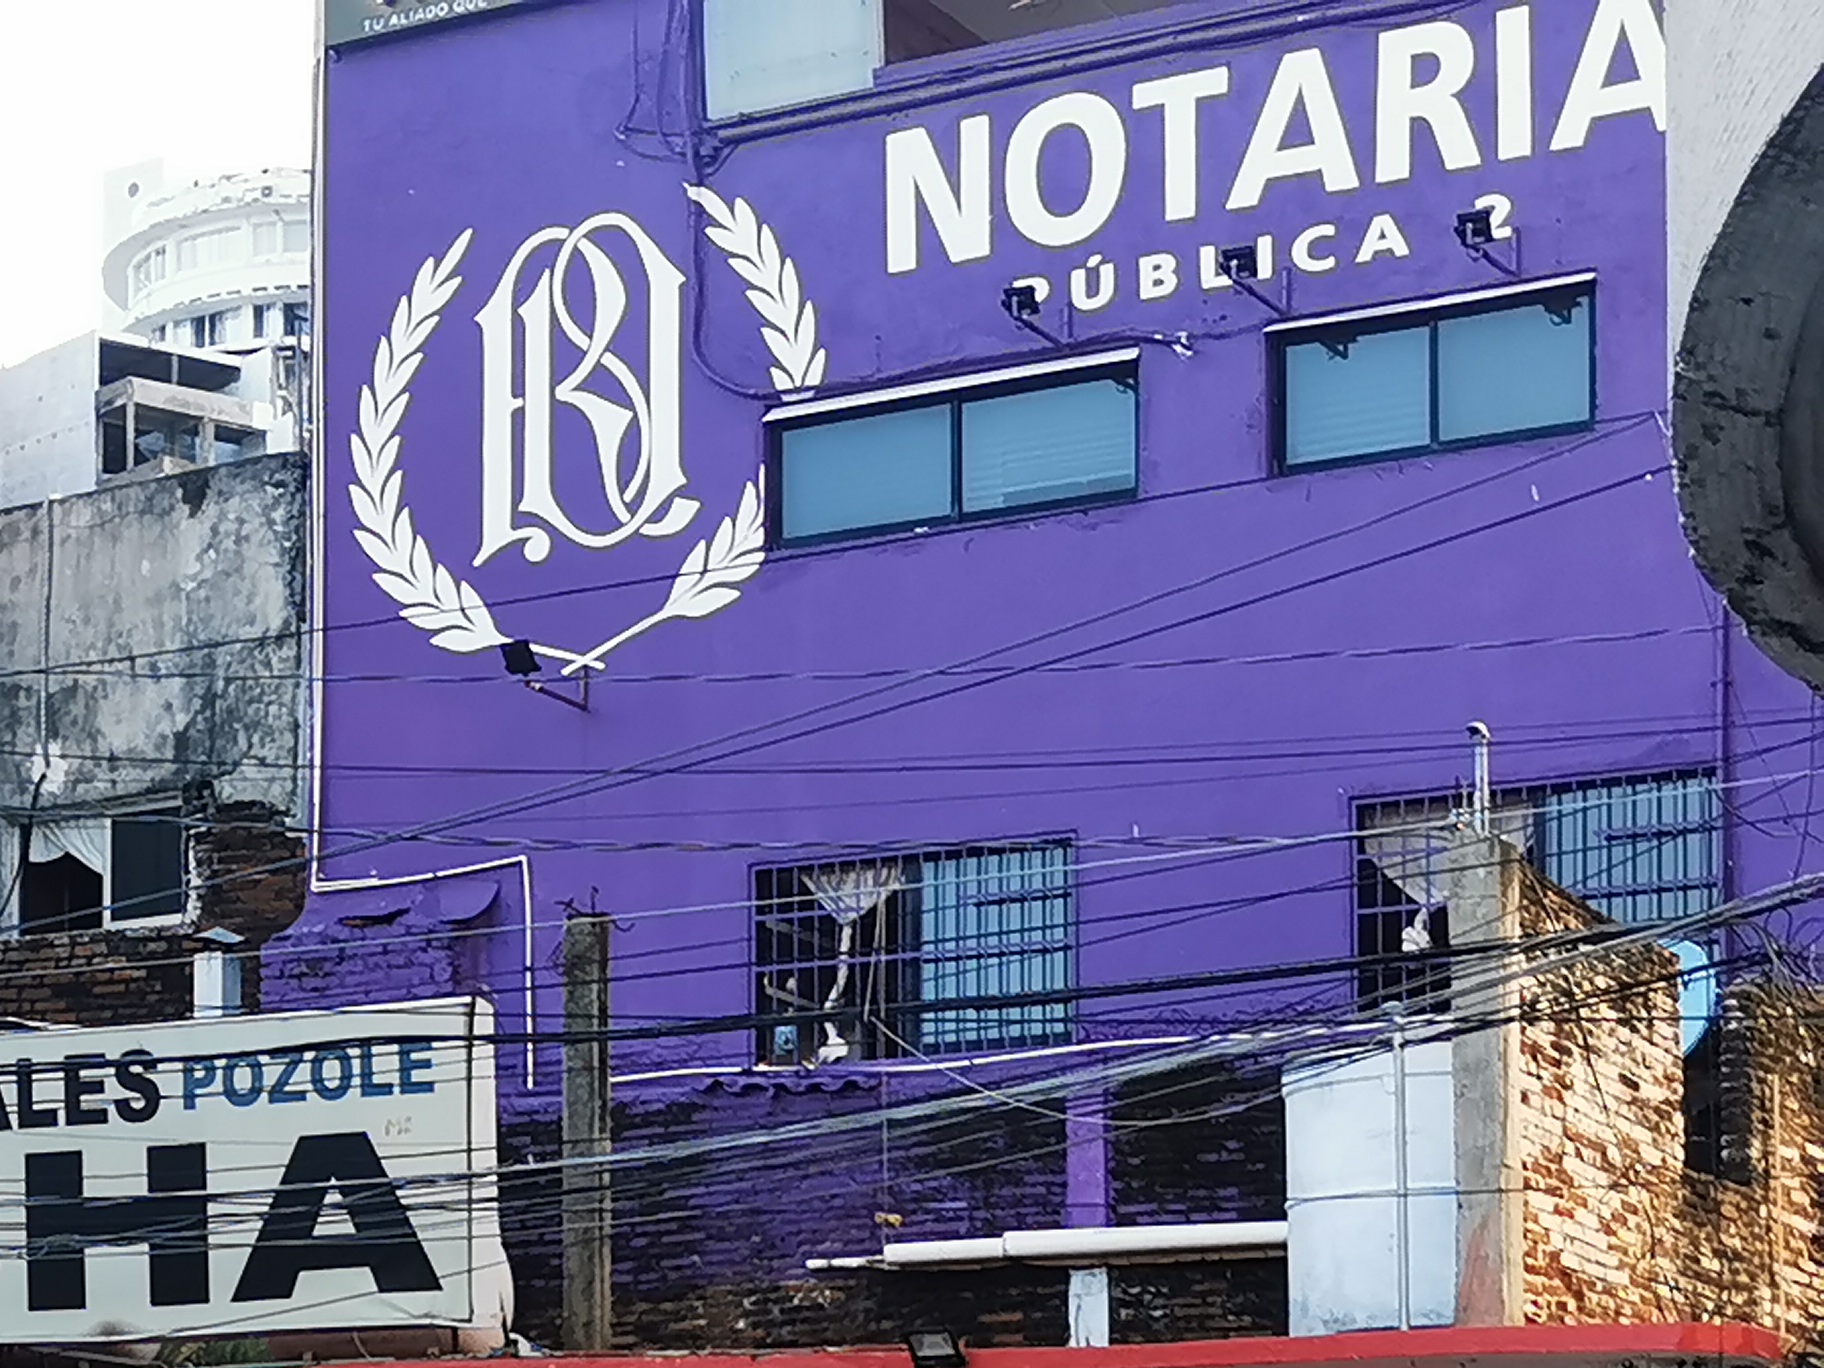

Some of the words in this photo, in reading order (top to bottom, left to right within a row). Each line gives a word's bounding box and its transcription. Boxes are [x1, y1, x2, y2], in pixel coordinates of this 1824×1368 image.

[363, 18, 384, 32] TU
[389, 3, 449, 26] ALIADO
[885, 0, 1666, 275] NOTARIA
[183, 1041, 435, 1110] POZOLE
